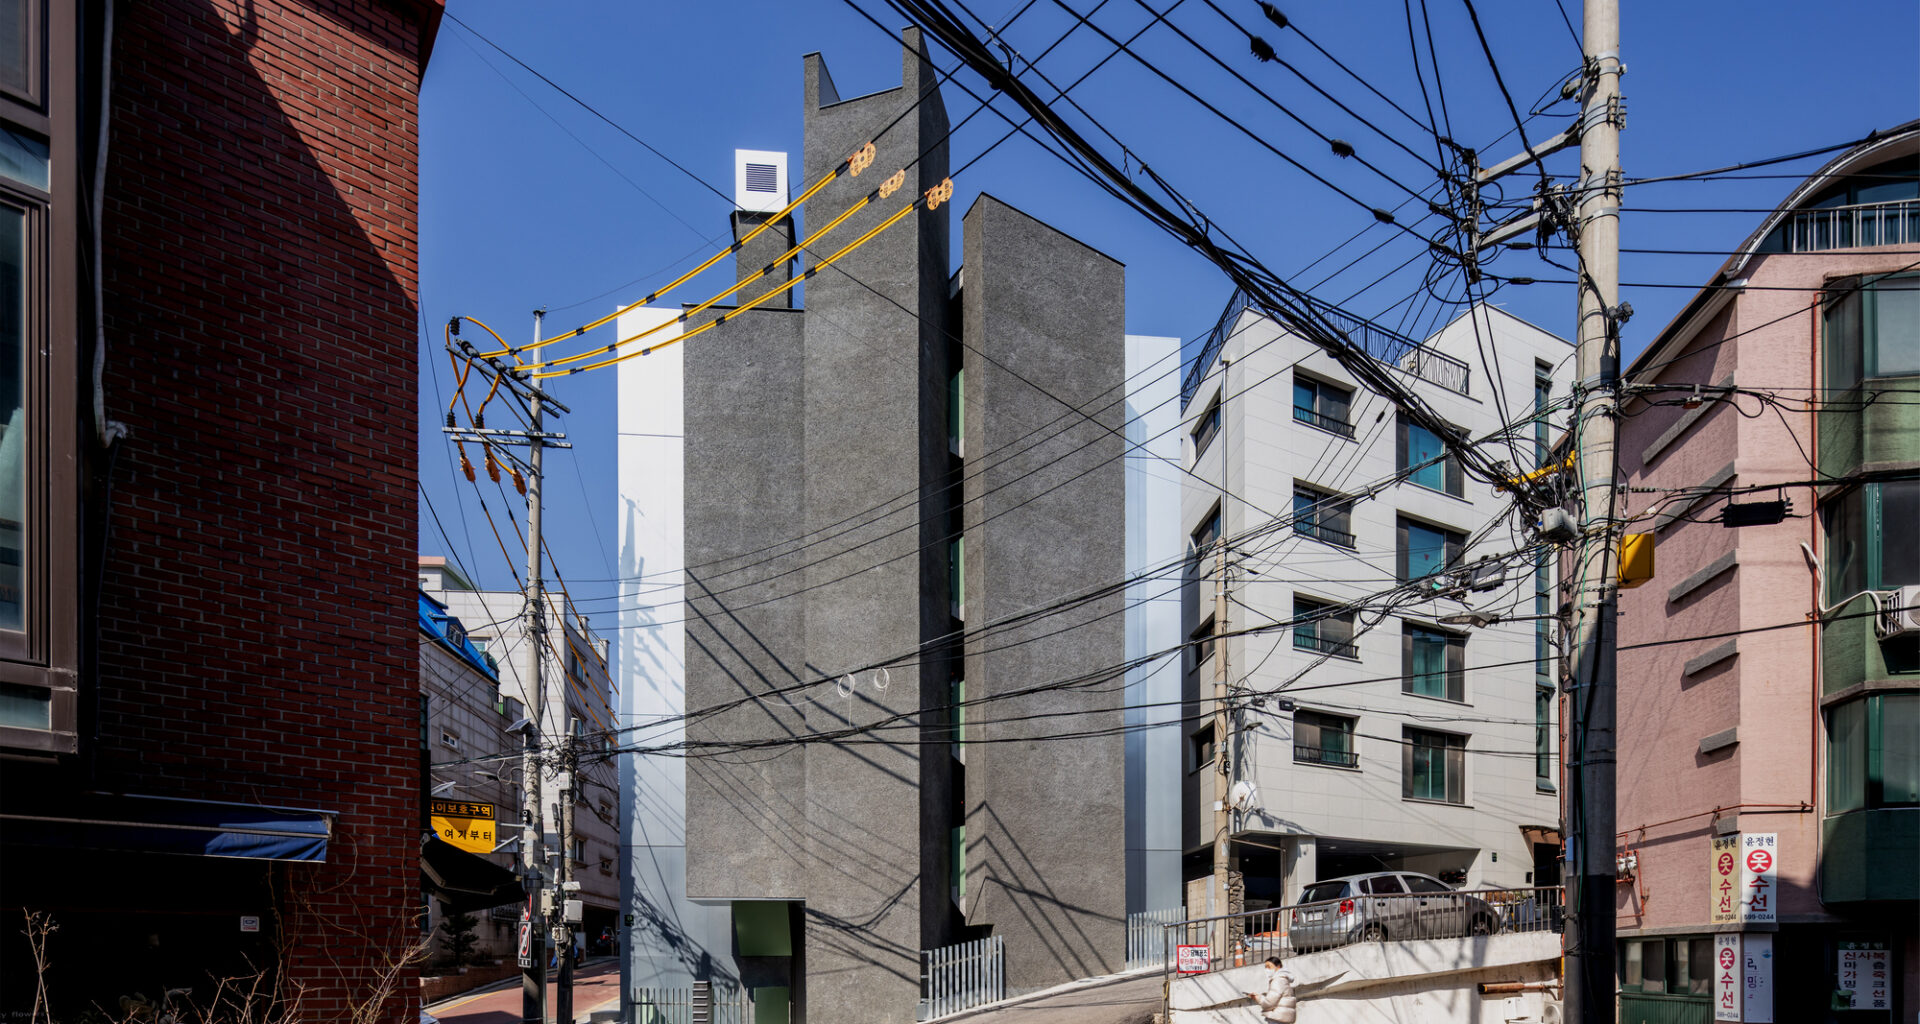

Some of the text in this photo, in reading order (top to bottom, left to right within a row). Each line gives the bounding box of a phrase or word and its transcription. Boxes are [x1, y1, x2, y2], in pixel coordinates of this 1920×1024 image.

[444, 828, 492, 841] 여기부터
[1714, 836, 1737, 850] 윤정현
[1745, 836, 1774, 847] 윤정현
